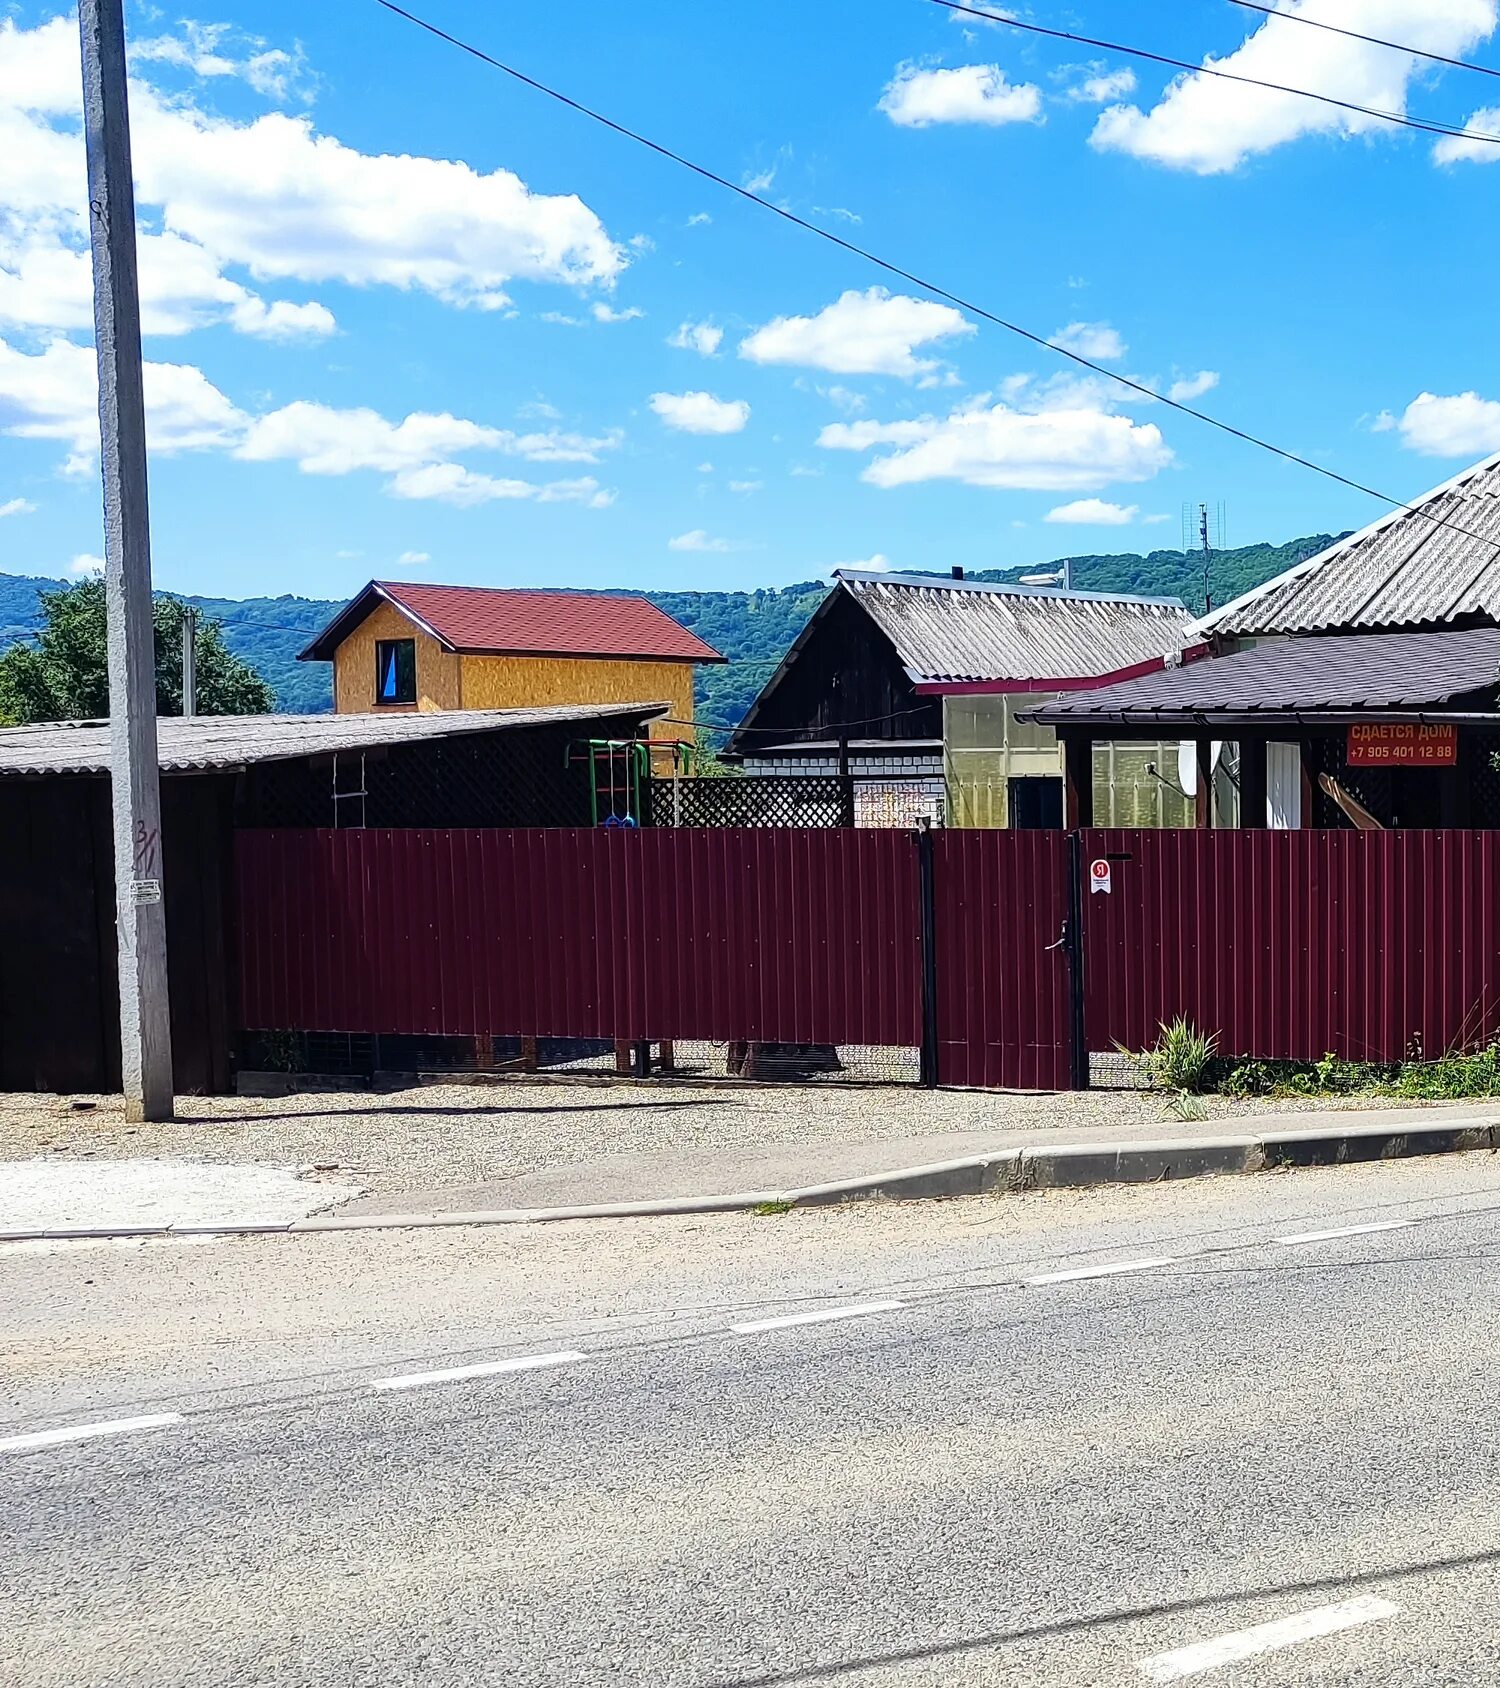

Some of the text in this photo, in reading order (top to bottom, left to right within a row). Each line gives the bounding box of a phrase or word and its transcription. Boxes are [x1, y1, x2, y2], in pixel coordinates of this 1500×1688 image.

[1351, 725, 1452, 741] СДАЕТСЯ ДОМ
[1351, 746, 1452, 758] +7 905 401 12 88
